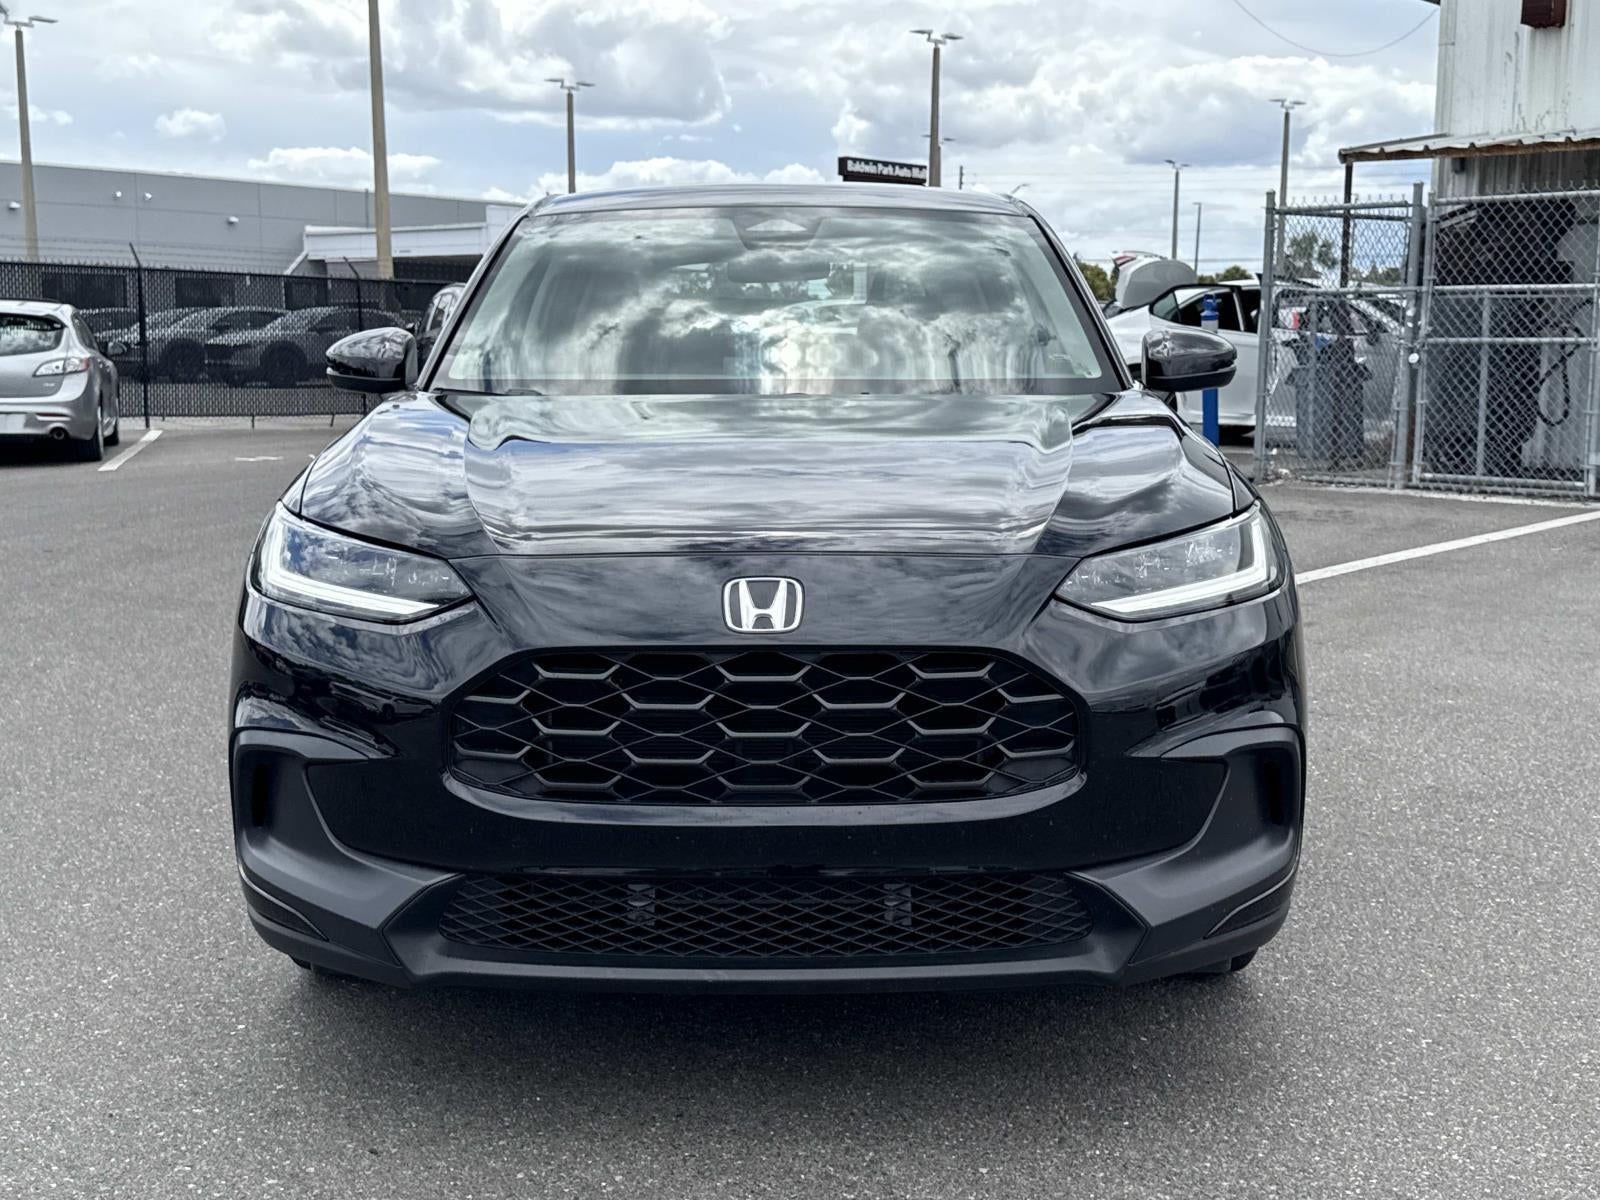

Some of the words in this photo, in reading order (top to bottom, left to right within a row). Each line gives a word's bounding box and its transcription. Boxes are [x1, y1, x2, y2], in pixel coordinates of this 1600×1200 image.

[847, 159, 876, 174] Baldwin
[877, 162, 893, 176] Park
[894, 165, 911, 177] Auto
